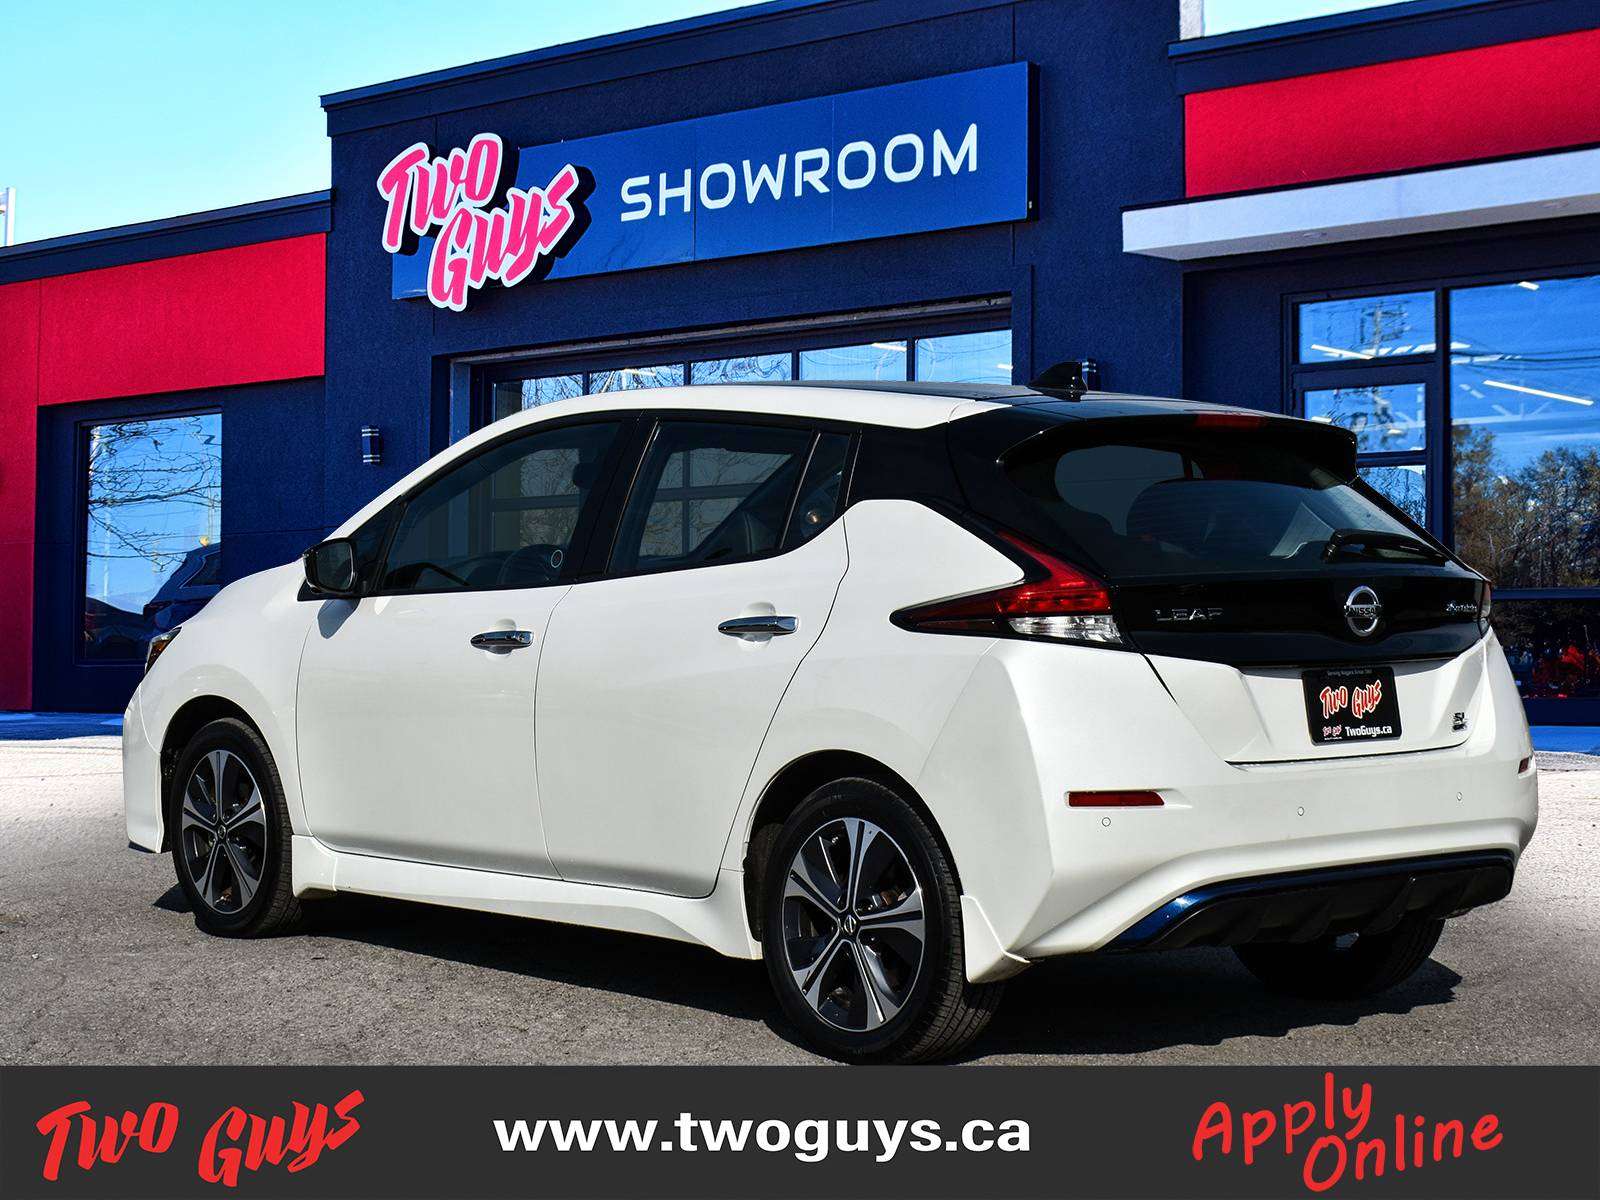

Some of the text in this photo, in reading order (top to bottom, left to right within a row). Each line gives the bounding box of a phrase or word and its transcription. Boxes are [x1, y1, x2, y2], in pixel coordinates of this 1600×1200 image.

[620, 123, 977, 222] SHOWROOM
[380, 136, 501, 249] Two
[429, 168, 577, 308] Guys
[1154, 607, 1224, 621] LEAF
[1347, 606, 1380, 617] NISSA
[1320, 680, 1381, 719] Two Guys
[1345, 725, 1392, 737] TwoGuys.ca
